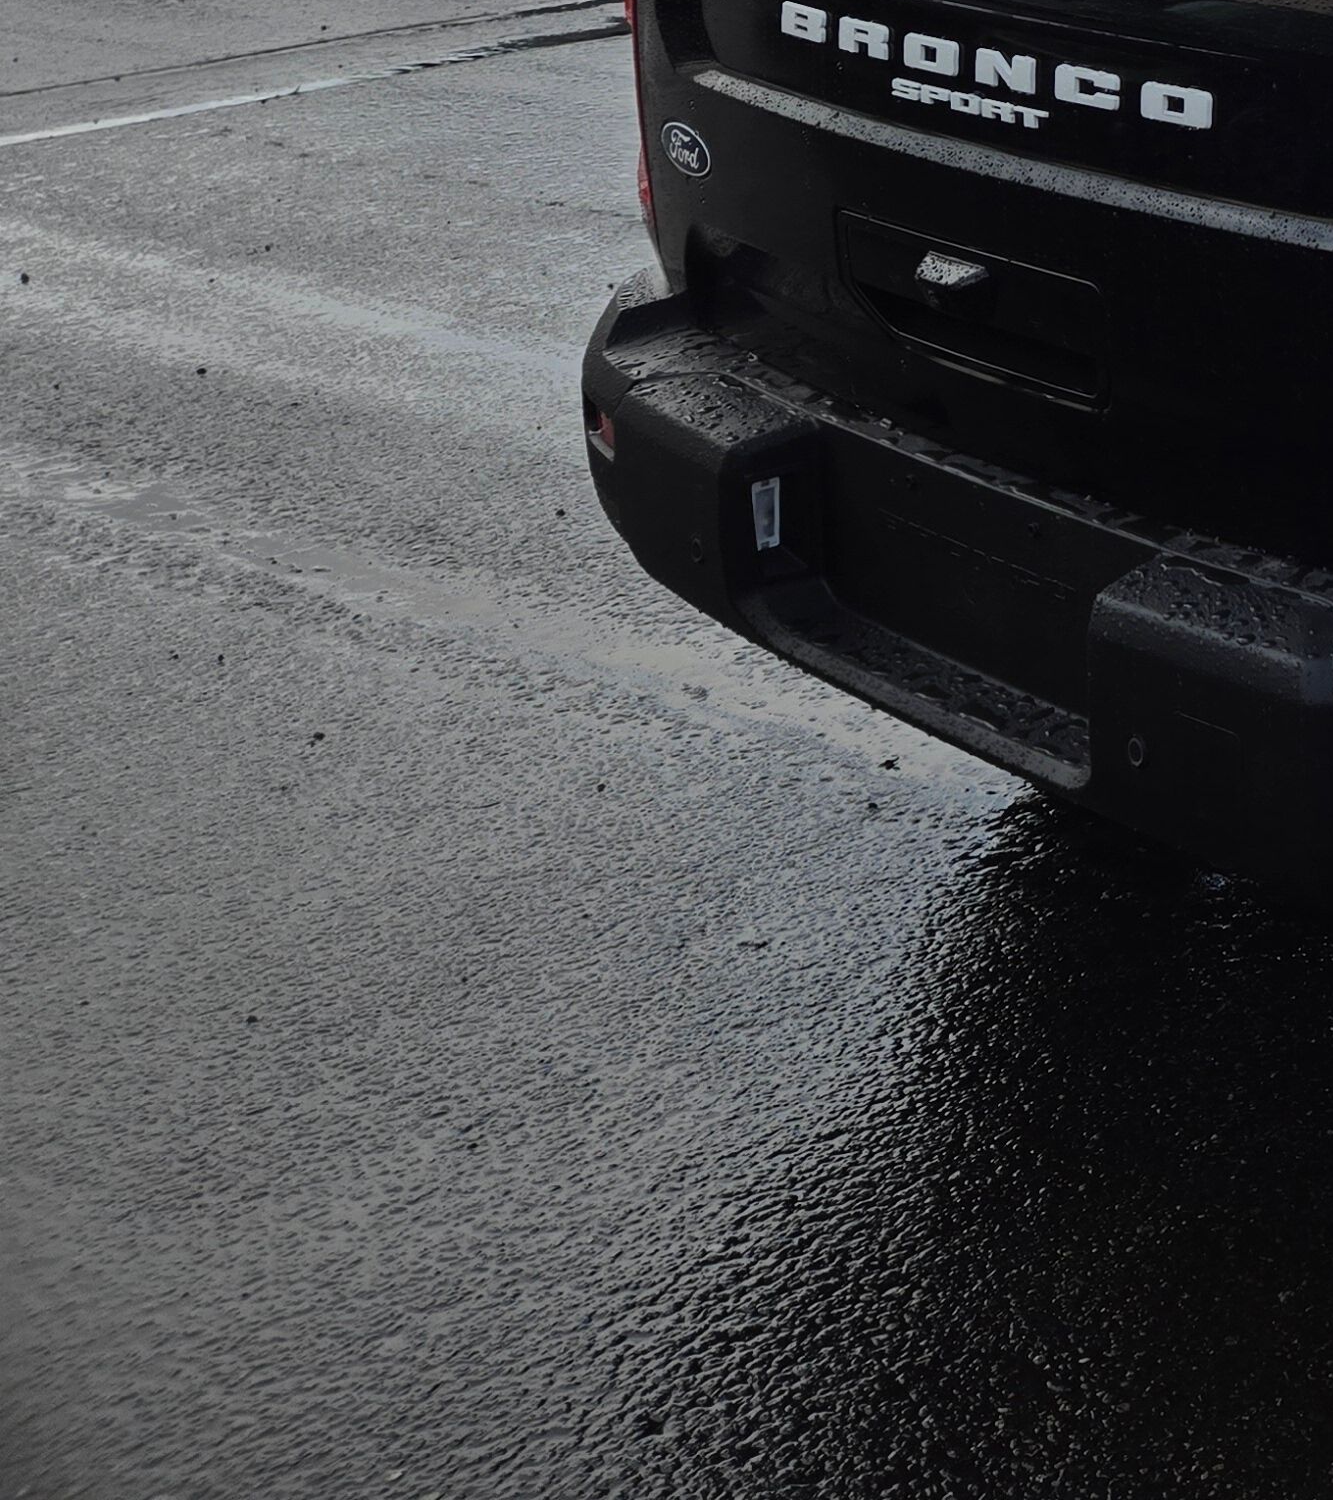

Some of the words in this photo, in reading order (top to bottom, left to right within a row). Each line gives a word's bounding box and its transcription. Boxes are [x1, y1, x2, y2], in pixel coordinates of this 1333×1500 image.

[780, 0, 1214, 130] BRONCO
[891, 77, 1050, 129] SPORT
[669, 128, 700, 169] Ford
